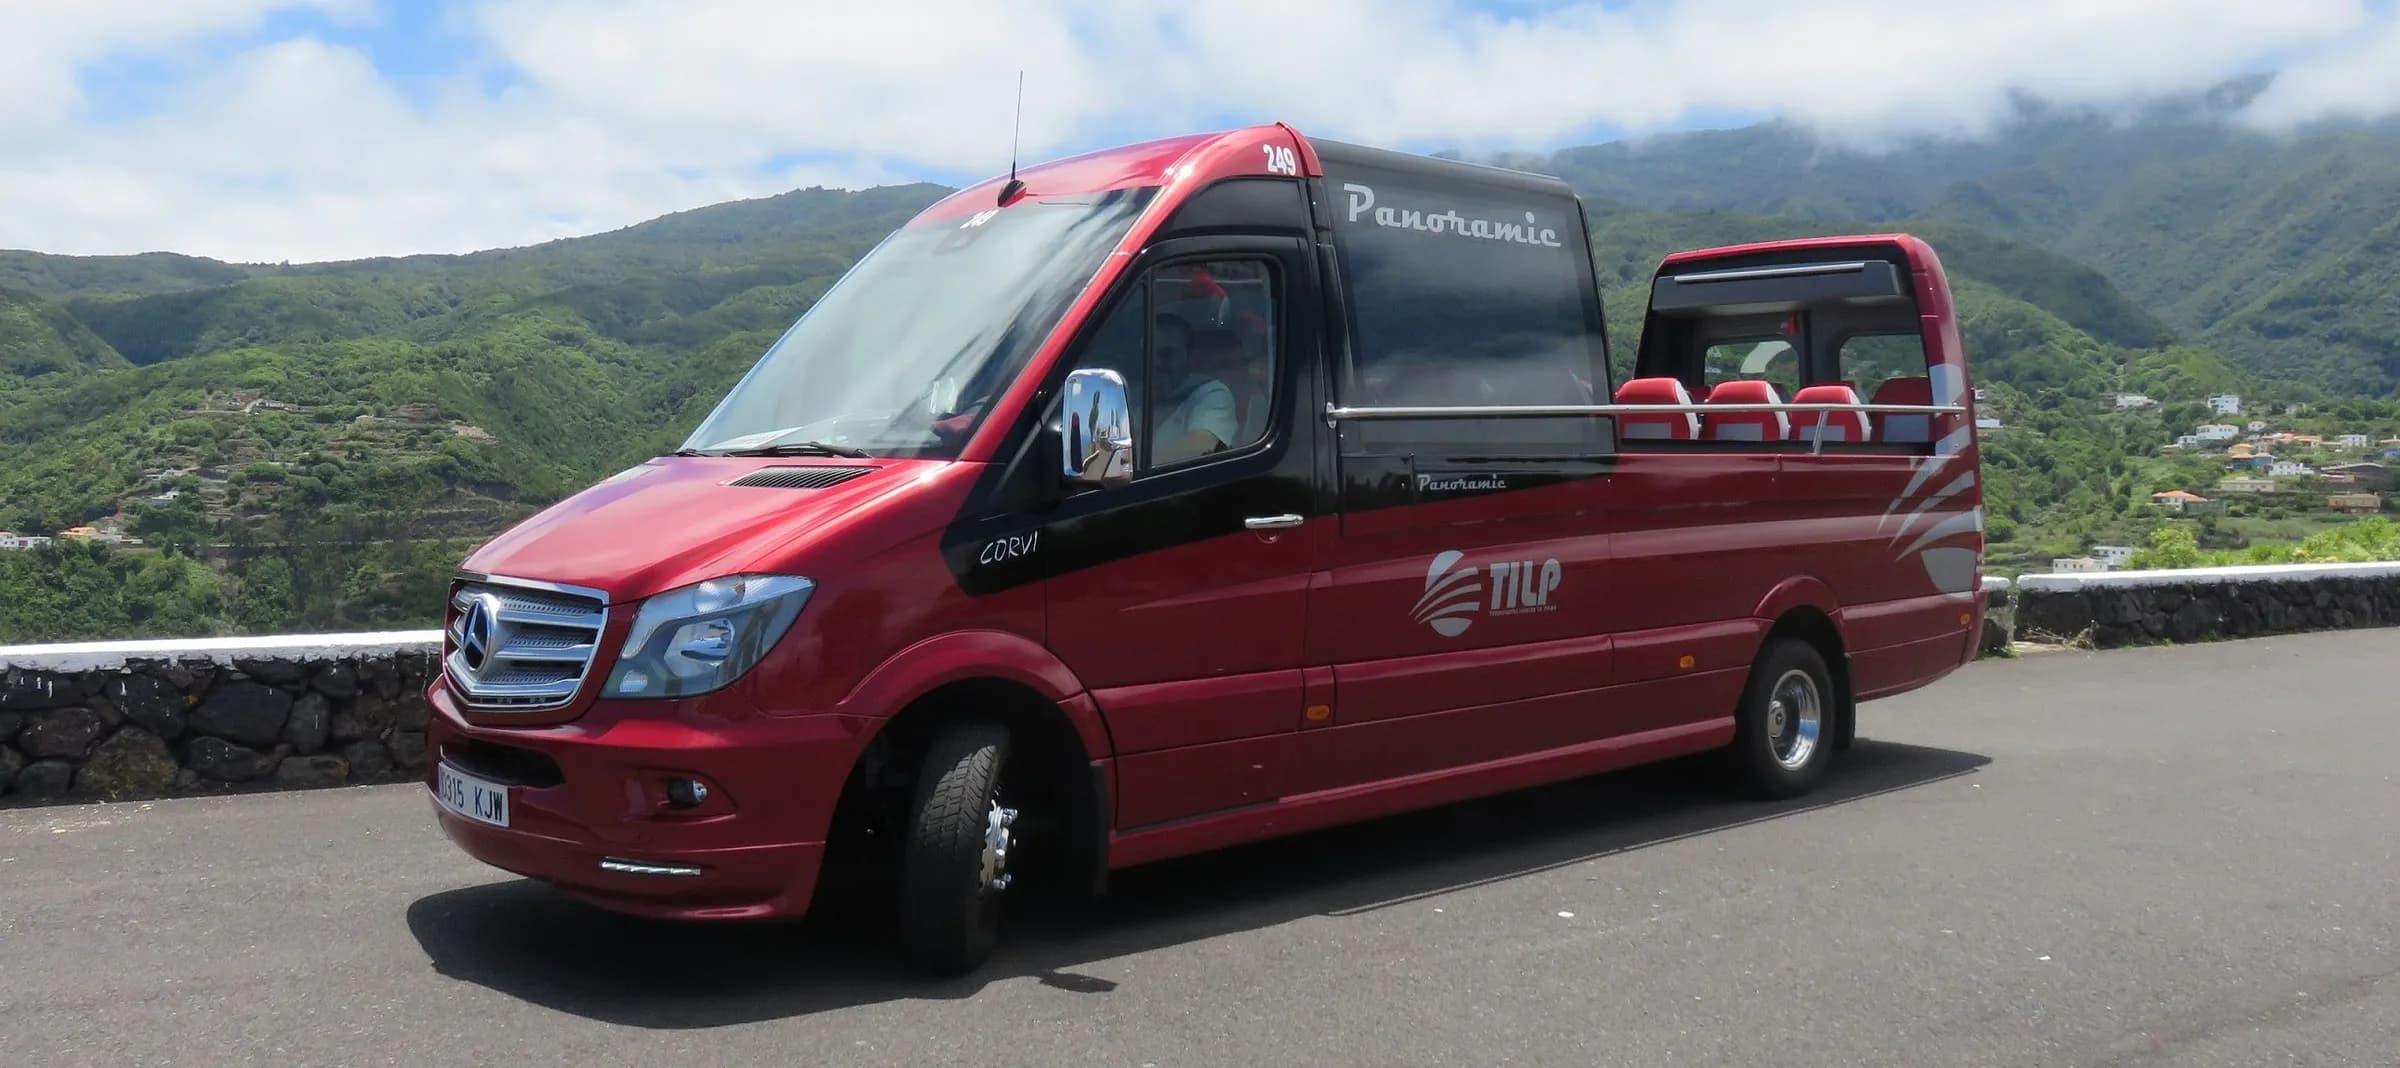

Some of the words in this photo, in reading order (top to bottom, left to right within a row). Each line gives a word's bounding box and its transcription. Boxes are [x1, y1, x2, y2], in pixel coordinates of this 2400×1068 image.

[1263, 144, 1296, 176] 249
[1343, 183, 1561, 247] Panoramic
[1417, 473, 1507, 492] Panoramic
[980, 530, 1038, 565] CORVI
[1489, 558, 1562, 610] TILP
[474, 785, 503, 822] KJW
